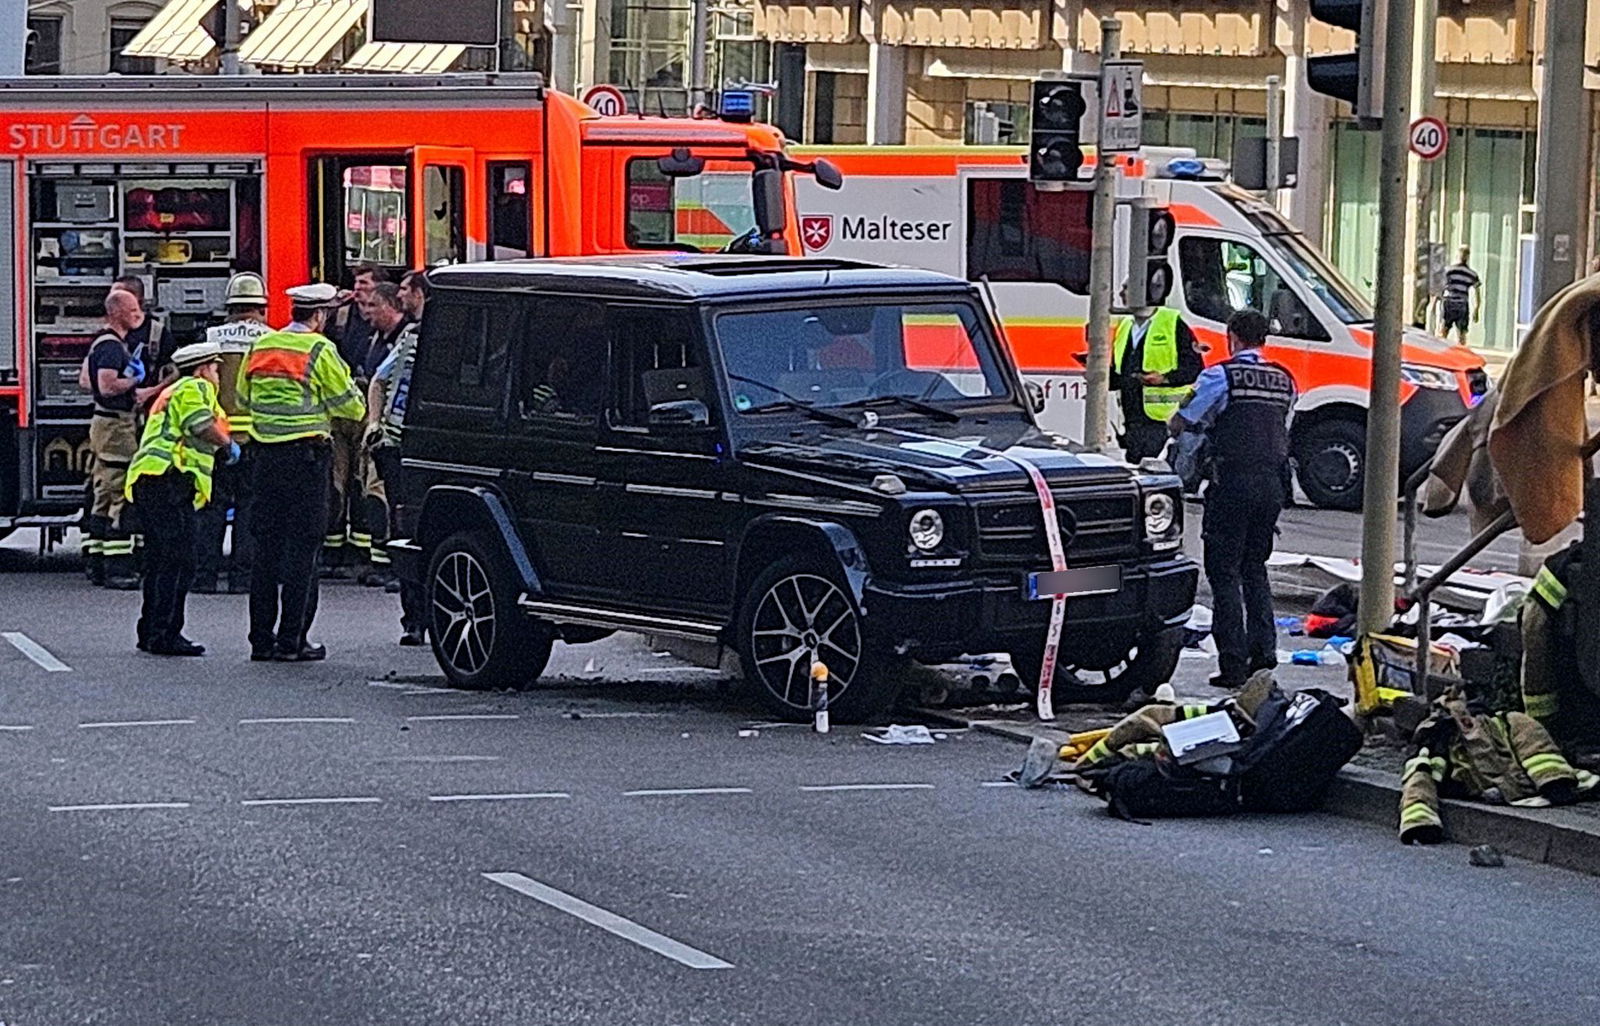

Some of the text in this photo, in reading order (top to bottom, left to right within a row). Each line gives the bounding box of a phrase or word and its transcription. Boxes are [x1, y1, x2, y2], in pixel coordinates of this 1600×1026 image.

[9, 115, 186, 149] STUTTGART
[1415, 128, 1439, 147] 40
[842, 215, 951, 240] Malteser
[217, 325, 267, 338] STUTTGA
